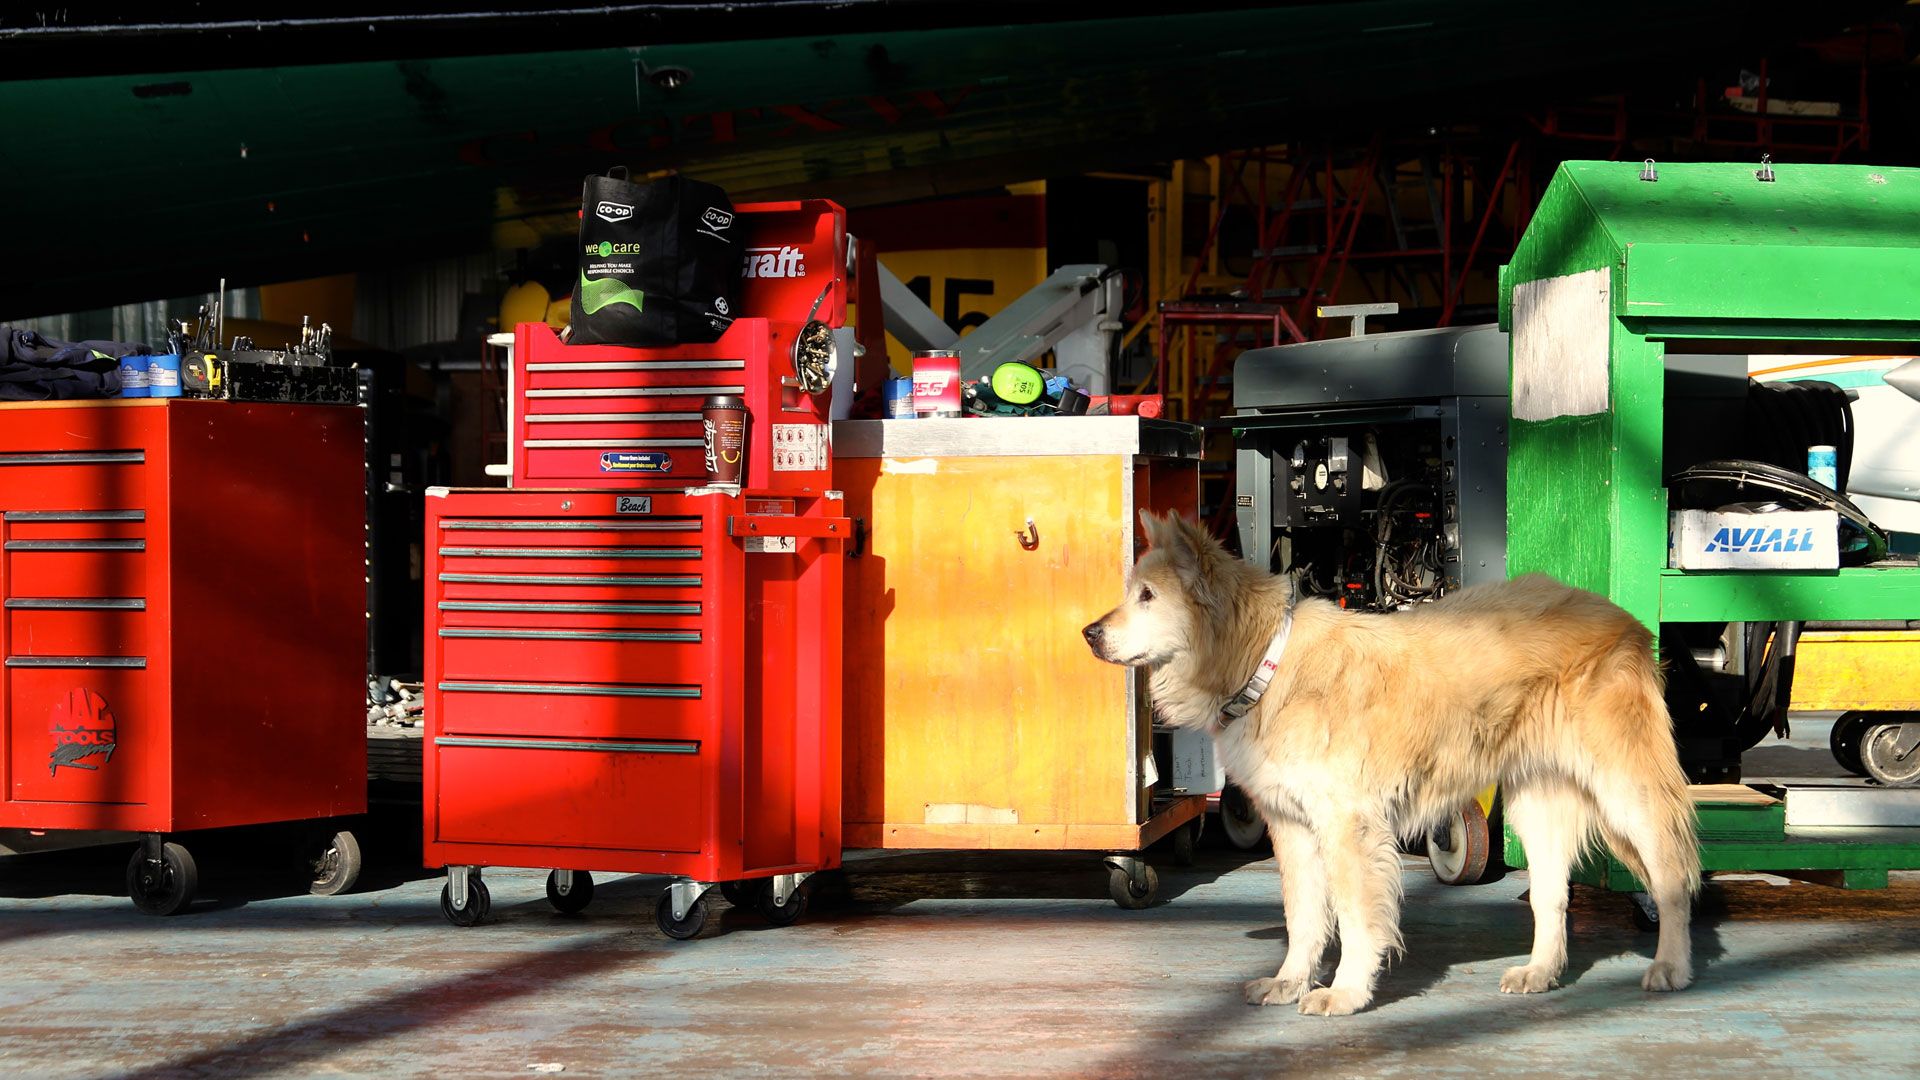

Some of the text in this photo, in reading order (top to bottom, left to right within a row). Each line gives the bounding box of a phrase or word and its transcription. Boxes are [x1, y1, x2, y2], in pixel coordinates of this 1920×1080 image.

[599, 206, 630, 217] CO-OP
[705, 211, 732, 226] CO-OP
[585, 242, 641, 254] we care
[1019, 381, 1028, 394] 105
[703, 418, 719, 474] McCafé
[620, 497, 647, 512] Beach
[1705, 527, 1814, 553] AVIALL
[48, 730, 114, 746] TOOLS
